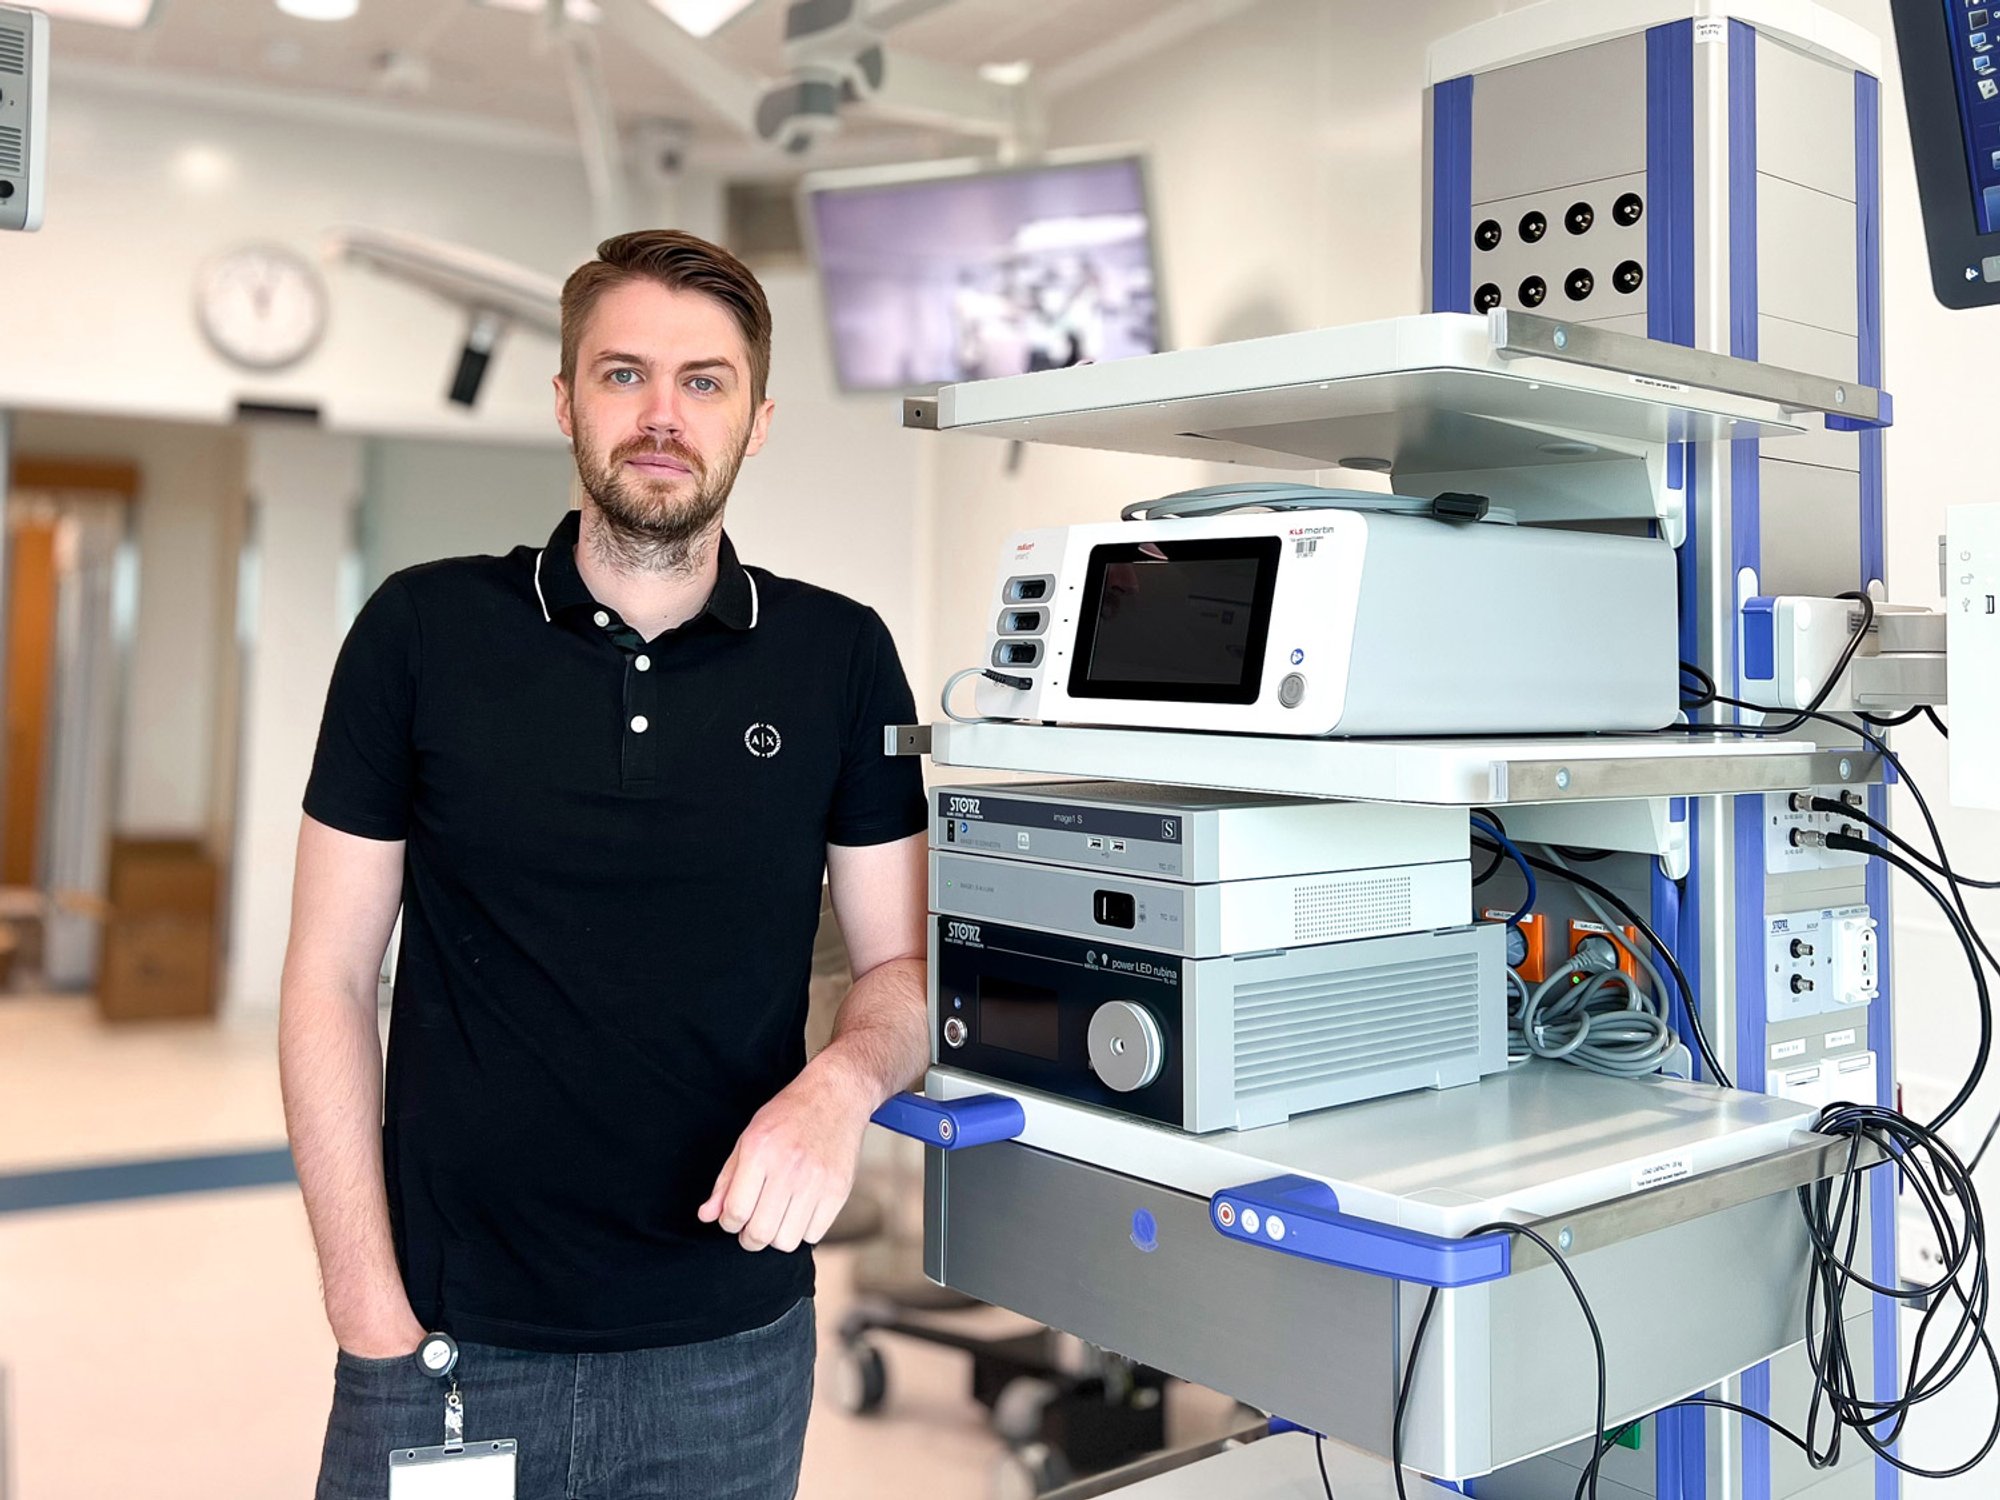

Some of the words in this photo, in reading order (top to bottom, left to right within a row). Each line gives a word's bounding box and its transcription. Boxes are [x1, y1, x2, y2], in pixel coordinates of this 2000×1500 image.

[950, 797, 980, 814] STORZ
[1164, 820, 1175, 838] S
[948, 921, 981, 942] STORZ
[1112, 960, 1135, 971] power
[1135, 962, 1152, 974] LED
[1153, 967, 1178, 979] rubina
